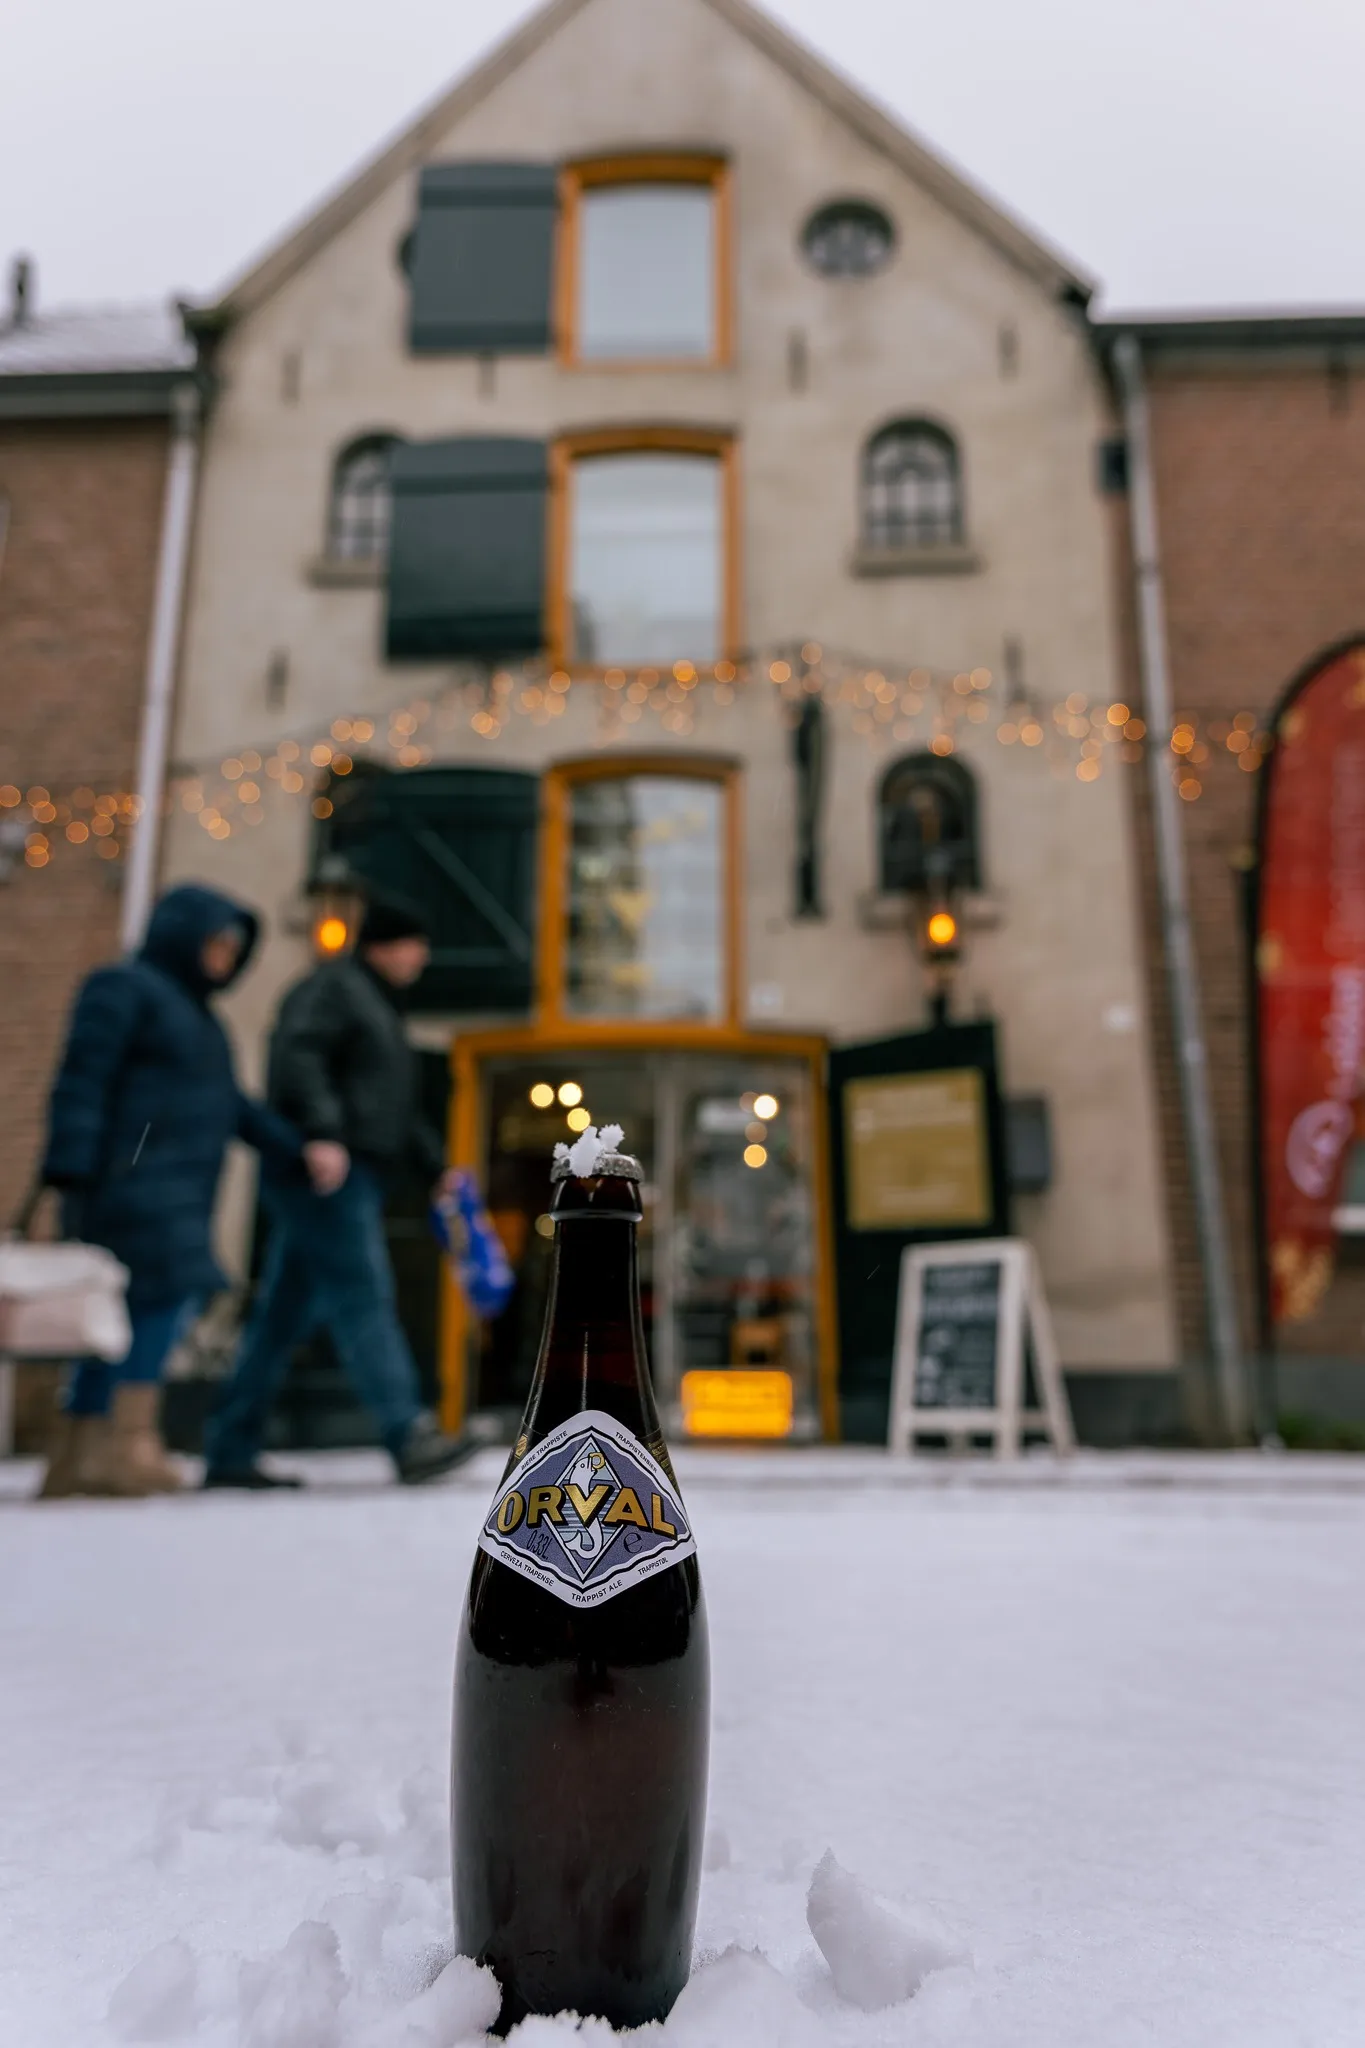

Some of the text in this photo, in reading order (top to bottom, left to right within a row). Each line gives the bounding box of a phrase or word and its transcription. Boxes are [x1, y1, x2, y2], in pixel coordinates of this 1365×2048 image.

[536, 1430, 568, 1456] TRAPPISTE
[615, 1431, 658, 1474] TRAPPISTENBIER
[497, 1484, 679, 1541] ORVAL
[500, 1550, 555, 1587] CERVEZA TRAPENSE
[571, 1579, 623, 1603] TRAPPIST ALE
